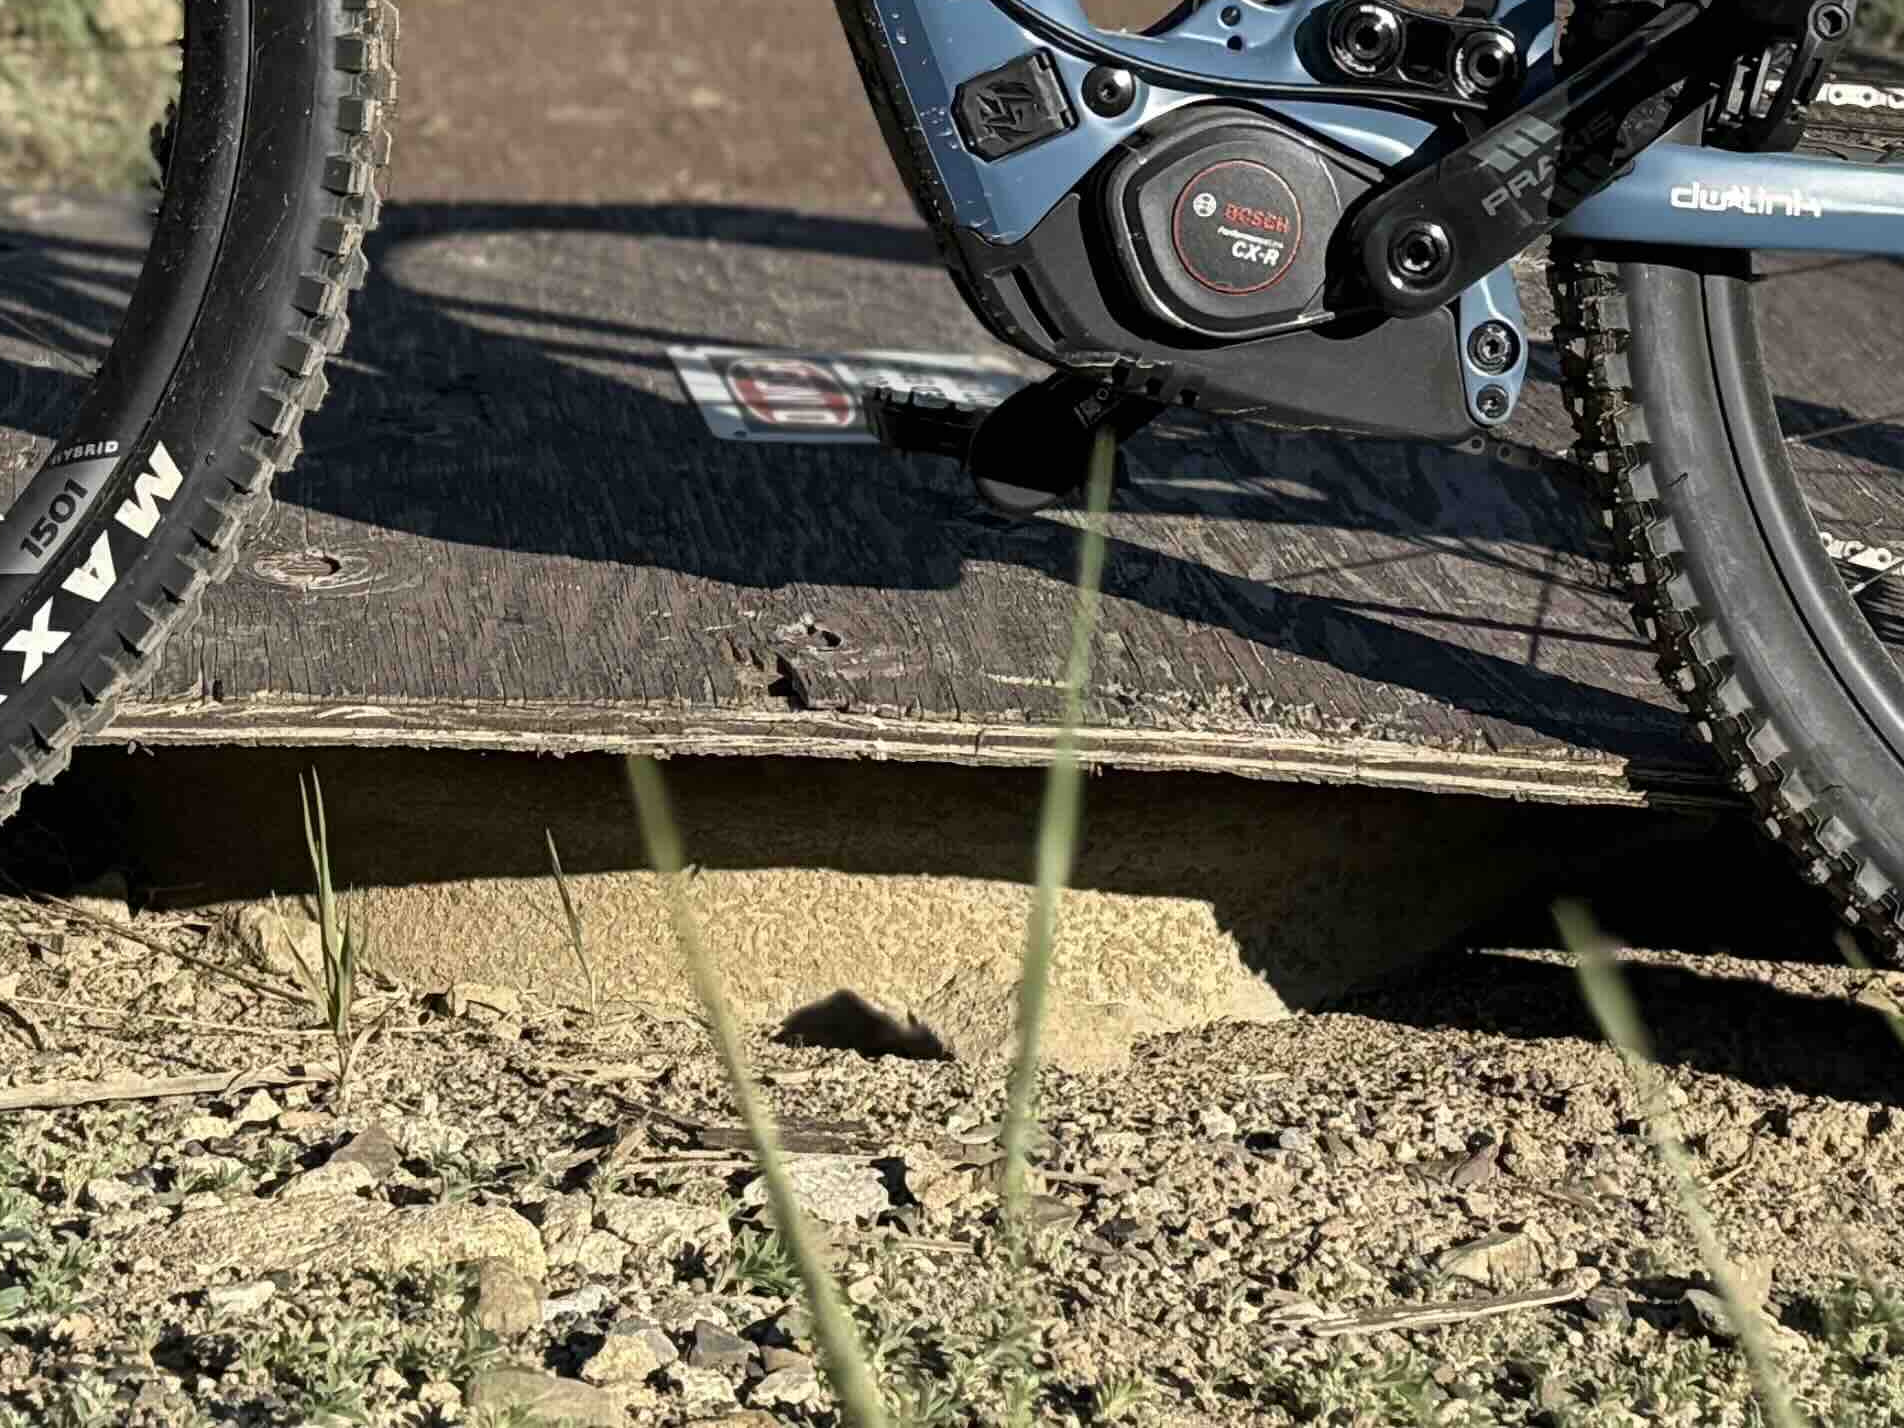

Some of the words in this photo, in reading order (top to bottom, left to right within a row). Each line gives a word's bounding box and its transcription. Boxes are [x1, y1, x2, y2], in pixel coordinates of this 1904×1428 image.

[1223, 202, 1290, 233] BOSCH
[1232, 240, 1280, 266] CX-R
[20, 479, 88, 559] 1501
